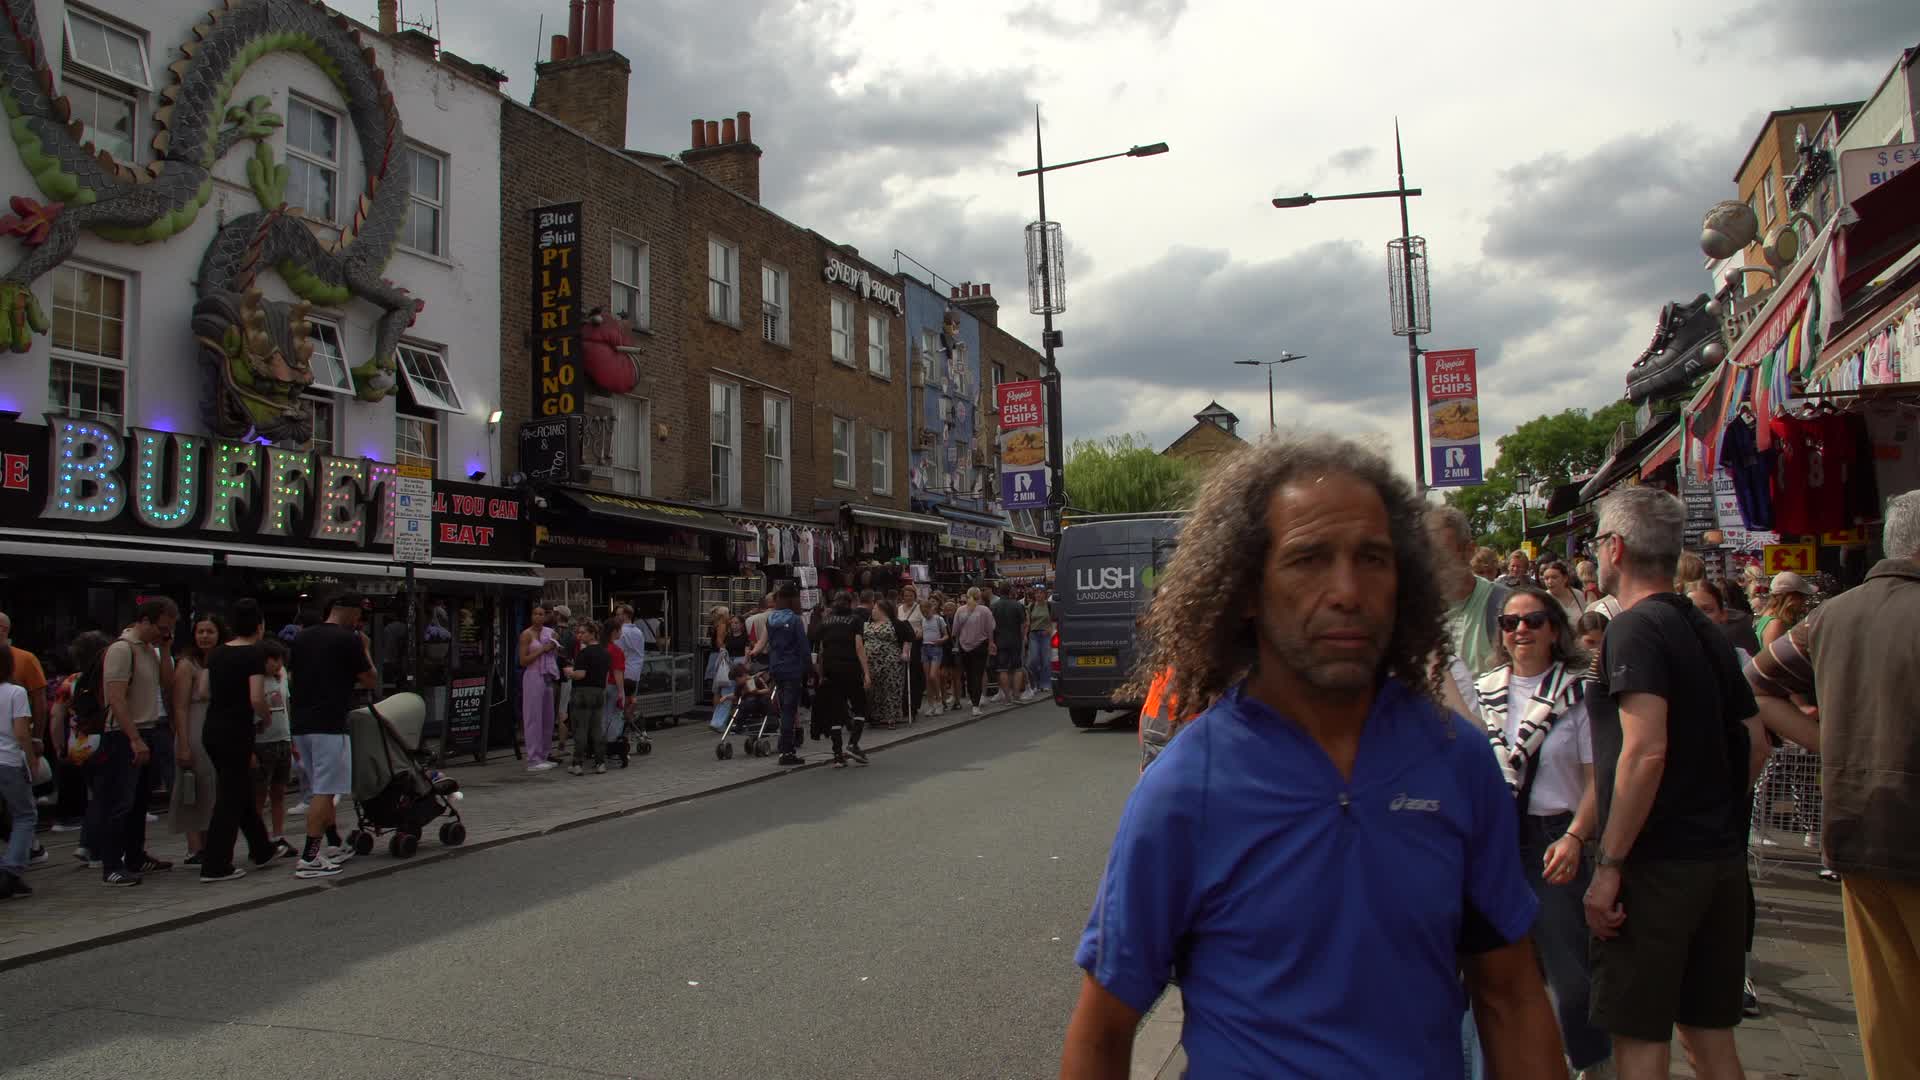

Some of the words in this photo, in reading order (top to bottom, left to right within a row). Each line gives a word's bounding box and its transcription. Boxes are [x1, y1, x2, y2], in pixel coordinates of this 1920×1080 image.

[1878, 152, 1888, 166] $
[1894, 150, 1904, 163] €
[540, 213, 573, 229] Blue
[539, 231, 575, 249] Skin
[824, 258, 860, 291] NEW
[871, 280, 904, 315] ROCK
[541, 248, 560, 415] PIERCING
[558, 247, 574, 413] TATTOO
[1432, 374, 1459, 384] FISH
[1463, 373, 1471, 381] &
[1432, 383, 1472, 394] CHIPS
[1004, 404, 1027, 414] FISH
[1030, 403, 1037, 411] &
[1004, 412, 1037, 423] CHIPS
[1444, 469, 1450, 477] 2
[1452, 468, 1469, 477] MIN
[1013, 493, 1019, 501] 2
[1020, 492, 1035, 500] MIN
[452, 494, 485, 516] YOU
[489, 499, 519, 520] CAN
[440, 523, 494, 546] EAT
[1772, 549, 1808, 571] £1
[1077, 567, 1135, 590] LUSH
[1077, 591, 1135, 600] LANDSCAPES
